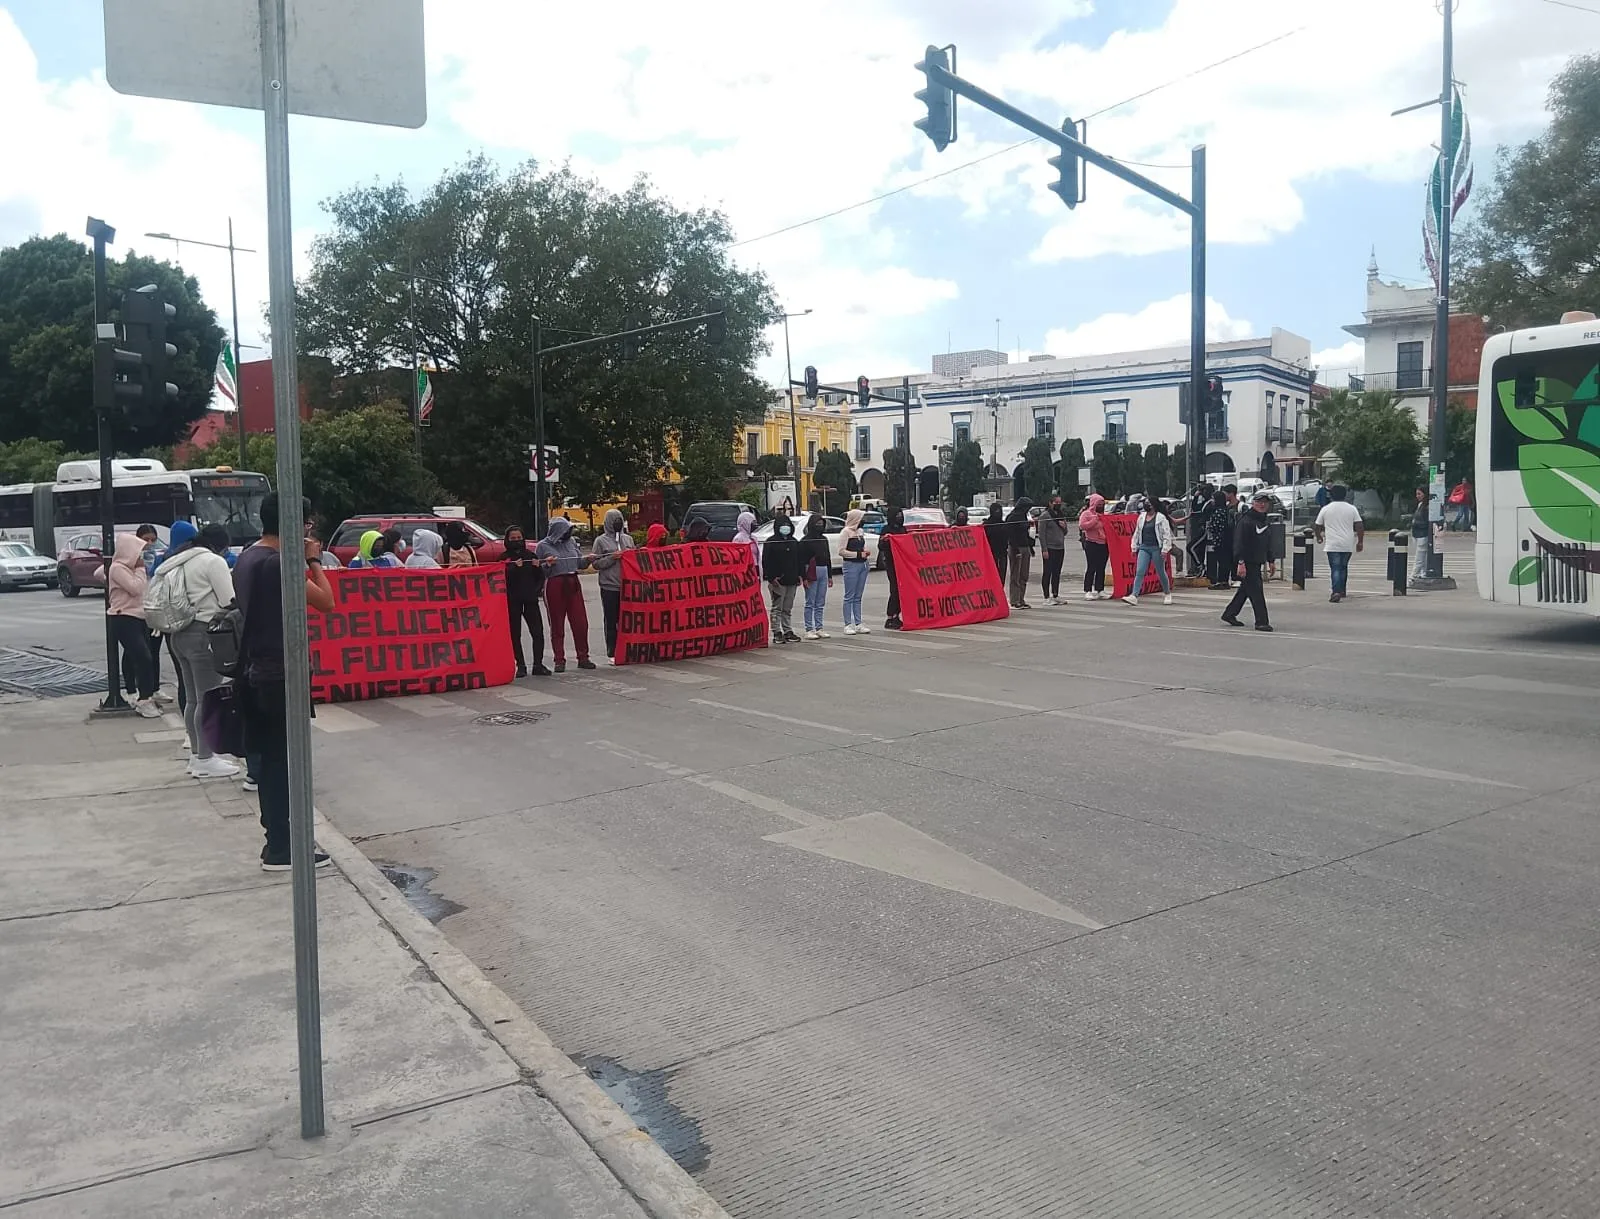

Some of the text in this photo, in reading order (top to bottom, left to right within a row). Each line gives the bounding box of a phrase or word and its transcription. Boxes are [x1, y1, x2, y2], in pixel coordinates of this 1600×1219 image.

[912, 529, 977, 555] QUEREMOS
[621, 573, 742, 603] CONSTITUCION
[918, 560, 982, 586] MAESTROS
[339, 574, 506, 604] PRESENTE
[917, 589, 999, 619] DE VOCACION
[376, 606, 490, 636] LUCHA,
[621, 610, 645, 634] DA
[649, 610, 671, 633] LA
[675, 600, 748, 631] LIBERTAD
[342, 639, 475, 674] FUTURO
